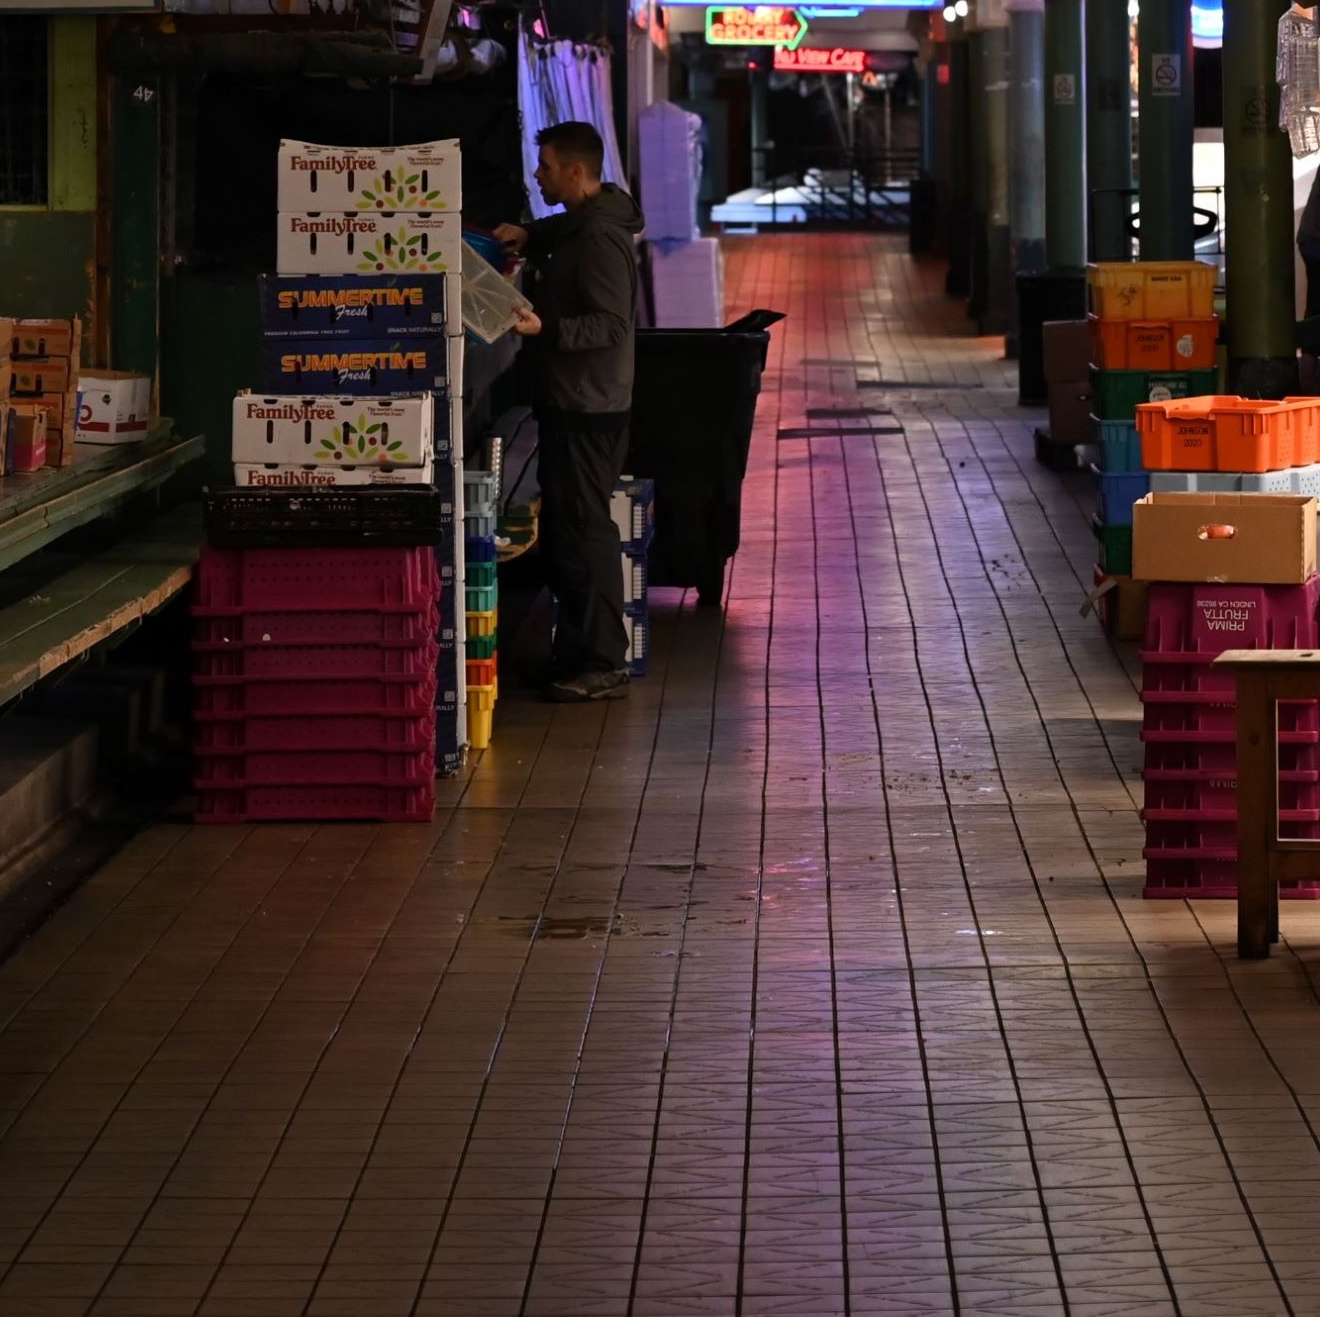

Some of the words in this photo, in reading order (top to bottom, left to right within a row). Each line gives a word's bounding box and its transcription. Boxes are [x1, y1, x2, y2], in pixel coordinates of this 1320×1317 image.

[711, 23, 799, 40] GROCERY
[291, 155, 377, 174] FamilyTree
[291, 218, 377, 237] FamilyTree
[277, 286, 424, 309] SUMMERTIME
[334, 304, 369, 321] Fresh
[281, 351, 428, 373] SUMMERTIME
[337, 368, 372, 385] Fresh
[247, 403, 335, 423] FamilyTree
[1177, 426, 1208, 434] JOHNSON
[1203, 609, 1249, 620] FRUTTA
[1206, 620, 1245, 632] PRIMA
